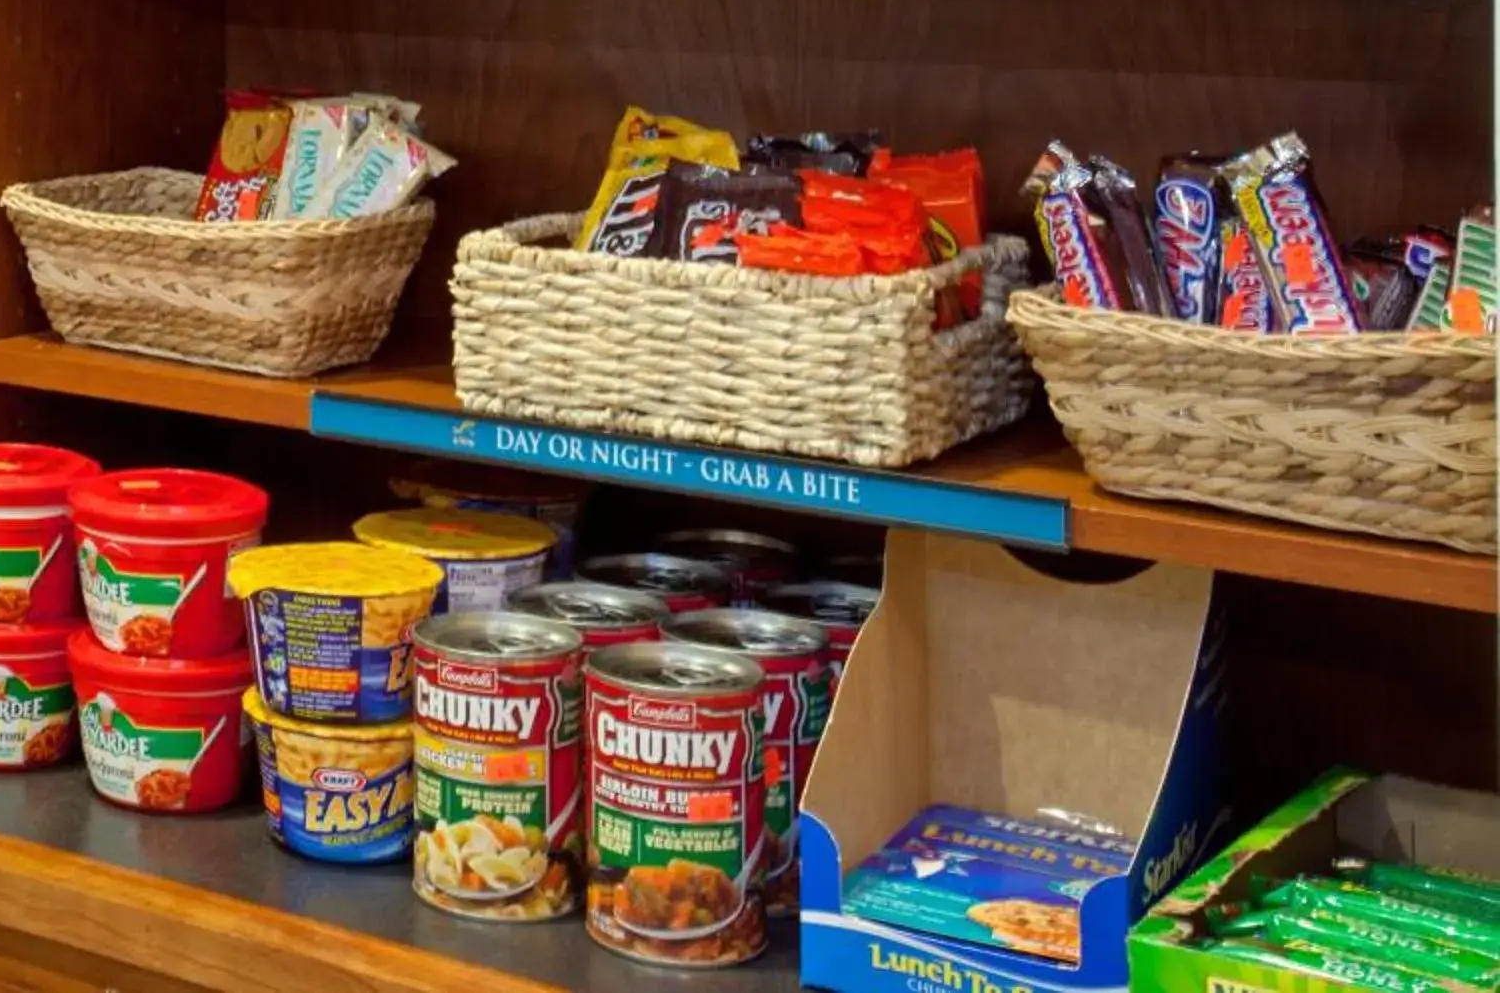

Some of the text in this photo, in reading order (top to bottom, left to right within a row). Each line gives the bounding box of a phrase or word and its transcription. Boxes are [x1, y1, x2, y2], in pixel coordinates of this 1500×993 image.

[495, 424, 540, 456] DAY
[548, 431, 586, 461] OR
[591, 436, 678, 477] NIGHT
[700, 456, 770, 490] GRAB
[775, 469, 796, 494] A
[802, 472, 861, 505] BITE
[417, 675, 541, 740] CHUNKY
[598, 710, 738, 775] CHUNKY
[304, 782, 392, 832] EASY
[922, 822, 1058, 863] Lunch
[868, 942, 963, 990] Lunch
